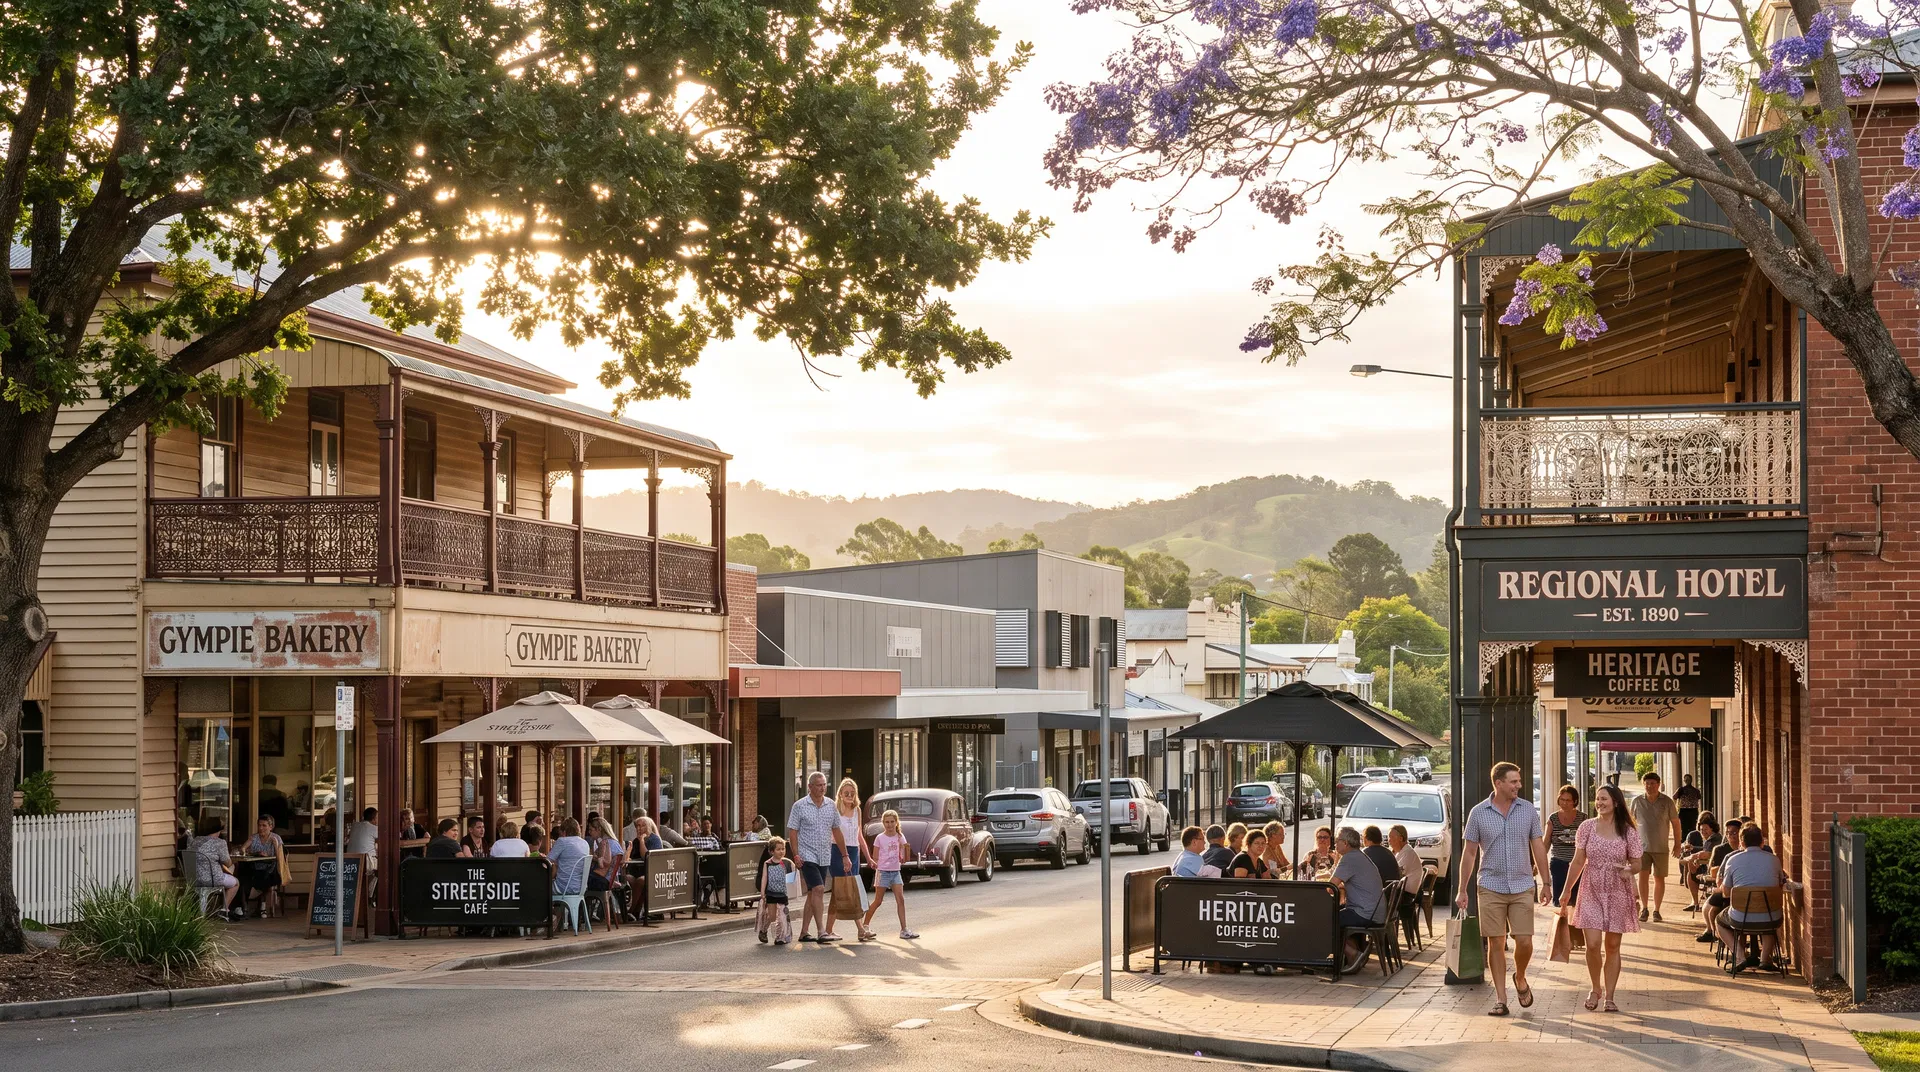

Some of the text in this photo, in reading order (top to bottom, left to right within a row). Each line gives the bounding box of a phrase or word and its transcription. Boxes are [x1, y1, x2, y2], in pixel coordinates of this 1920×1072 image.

[1498, 568, 1786, 599] REGIONAL HOTEL
[1602, 607, 1679, 622] EST. 1890
[159, 624, 368, 654] GYMPIE BAKERY
[516, 631, 642, 664] GYMPIE BAKERY
[1588, 652, 1701, 676] HERITAGE
[1608, 678, 1659, 692] COFFEE
[467, 868, 485, 880] THE
[654, 870, 688, 889] STREETSIDE
[431, 882, 520, 900] STREETSIDE
[464, 900, 488, 914] CAFÉ
[1199, 899, 1296, 924] HERITAGE
[1216, 924, 1280, 939] COFFEE CO.
